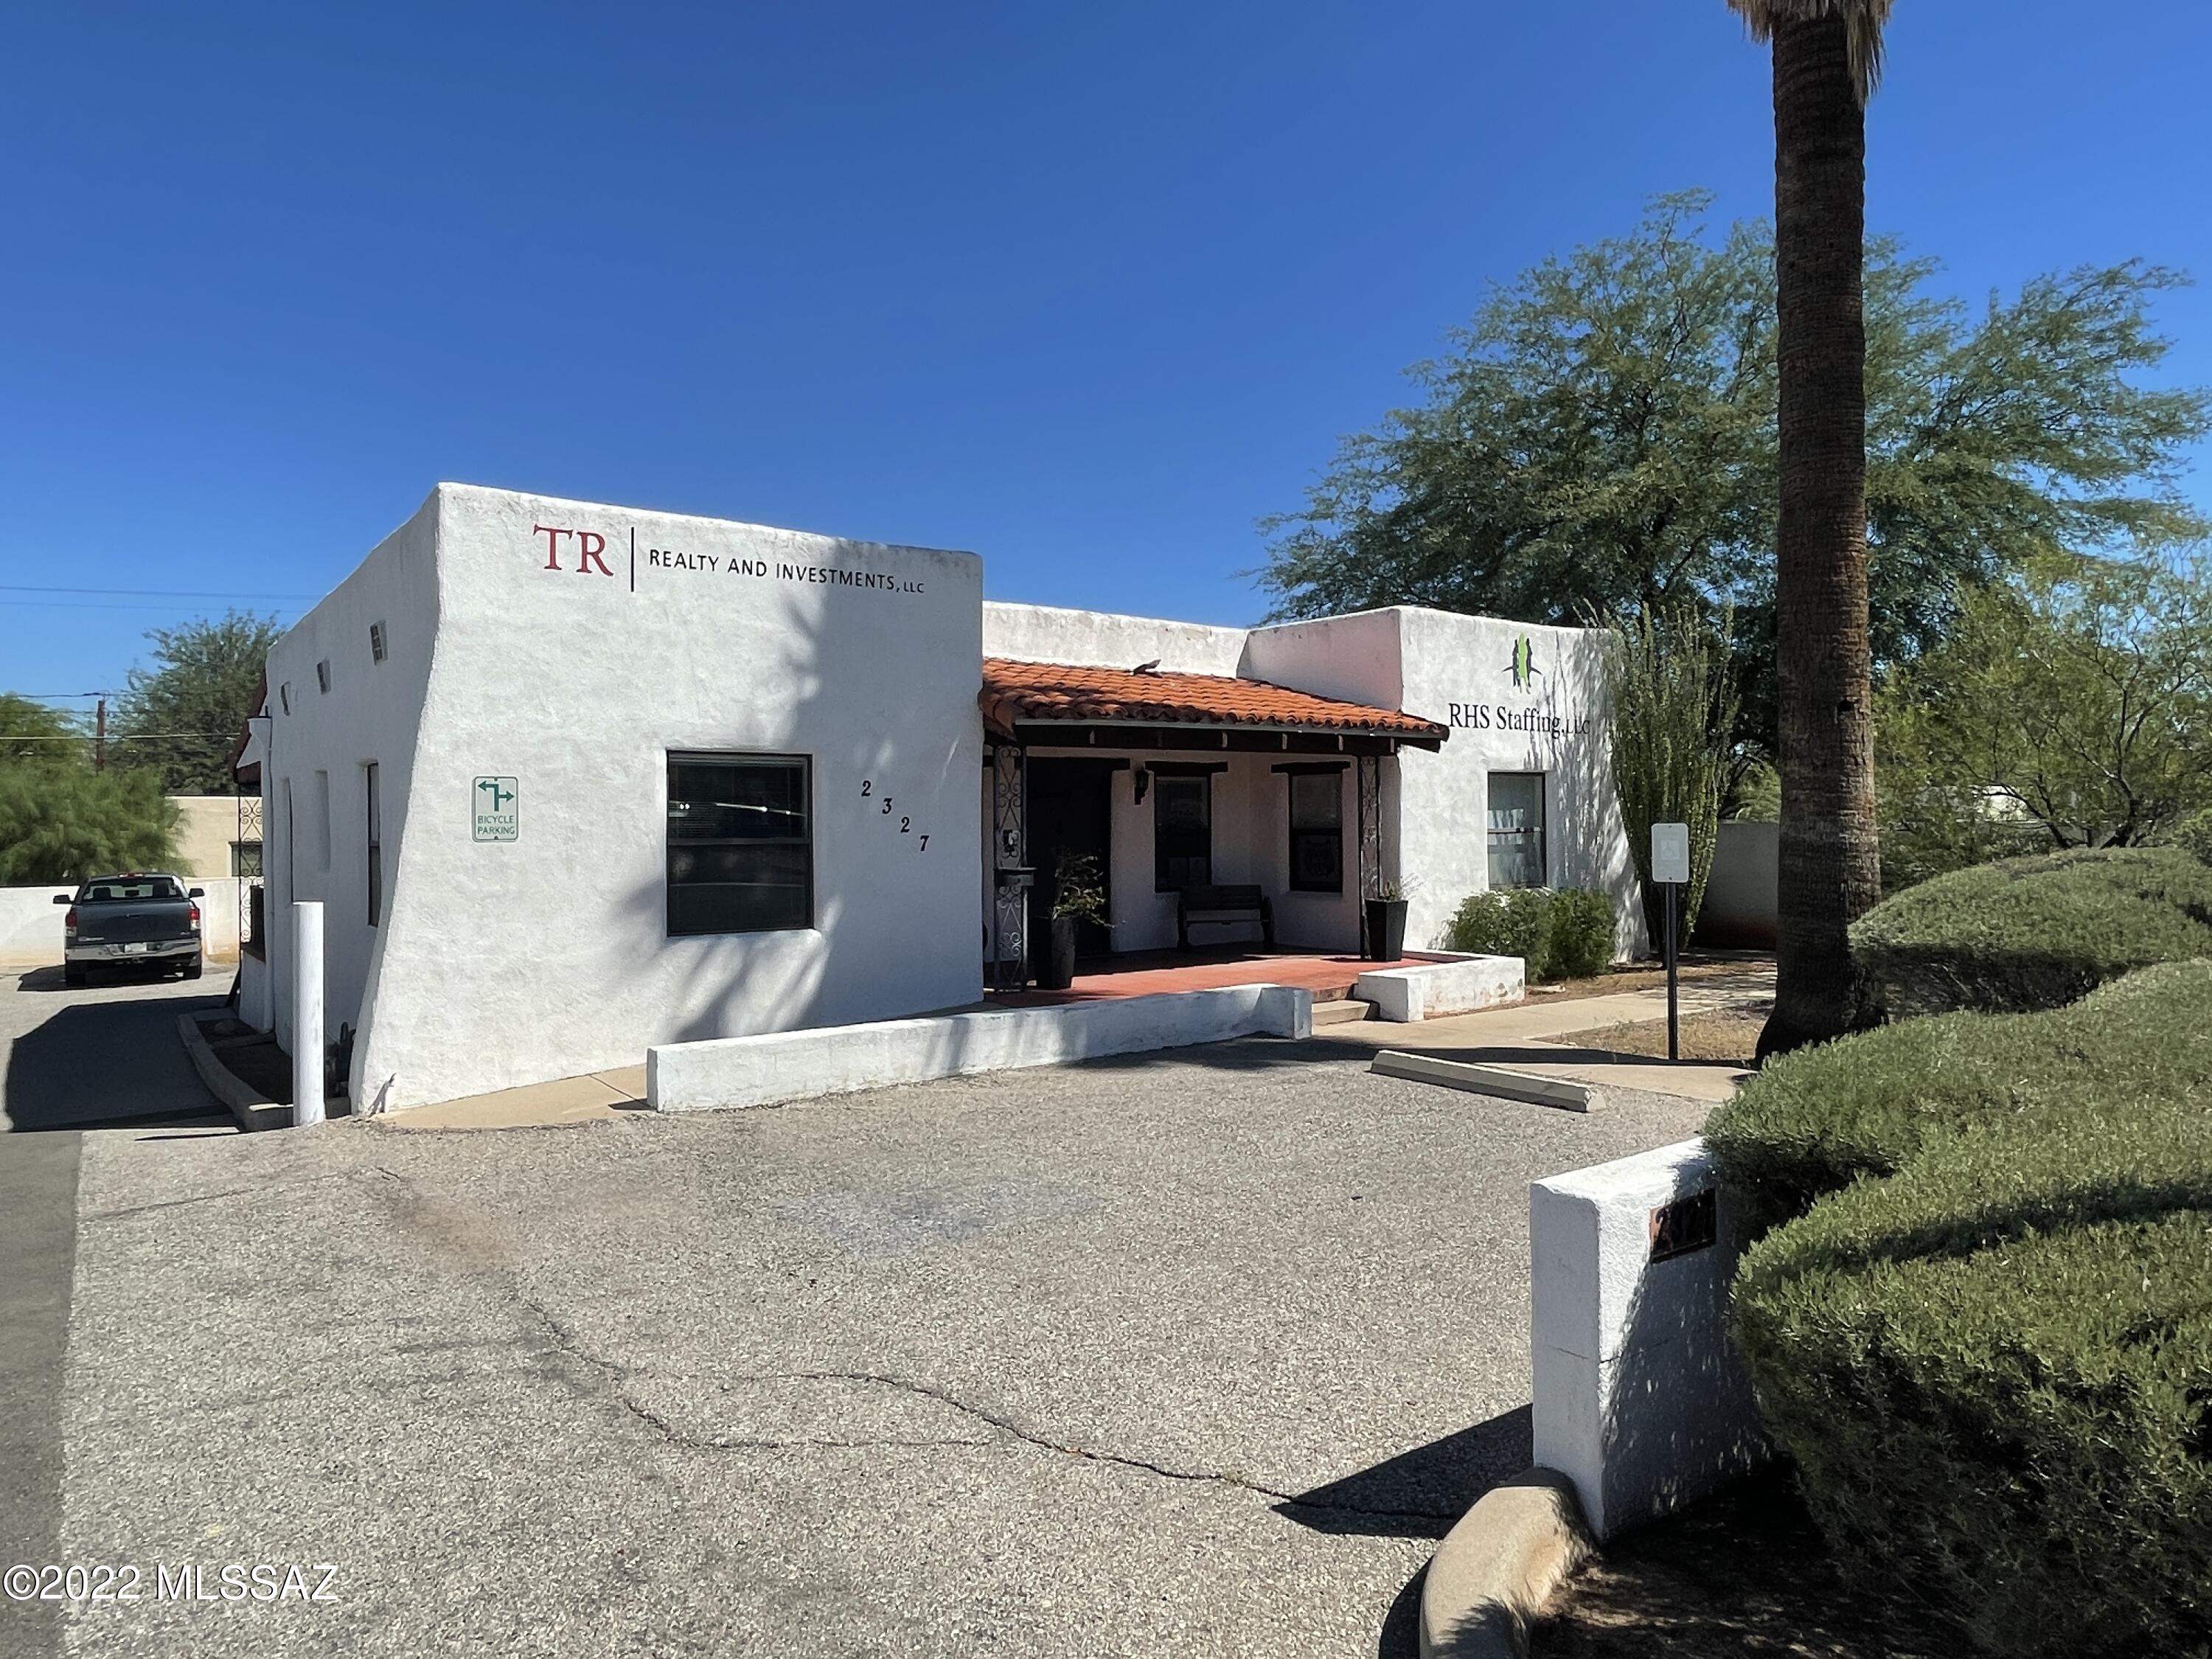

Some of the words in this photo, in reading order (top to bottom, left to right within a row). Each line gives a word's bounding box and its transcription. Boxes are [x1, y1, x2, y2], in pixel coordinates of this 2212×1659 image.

[532, 524, 613, 577] TR
[649, 549, 719, 571] REALTY
[727, 558, 768, 577] AND
[1448, 703, 1490, 729] RHS
[477, 815, 514, 824] BICYCLE
[477, 826, 515, 835] PARKING
